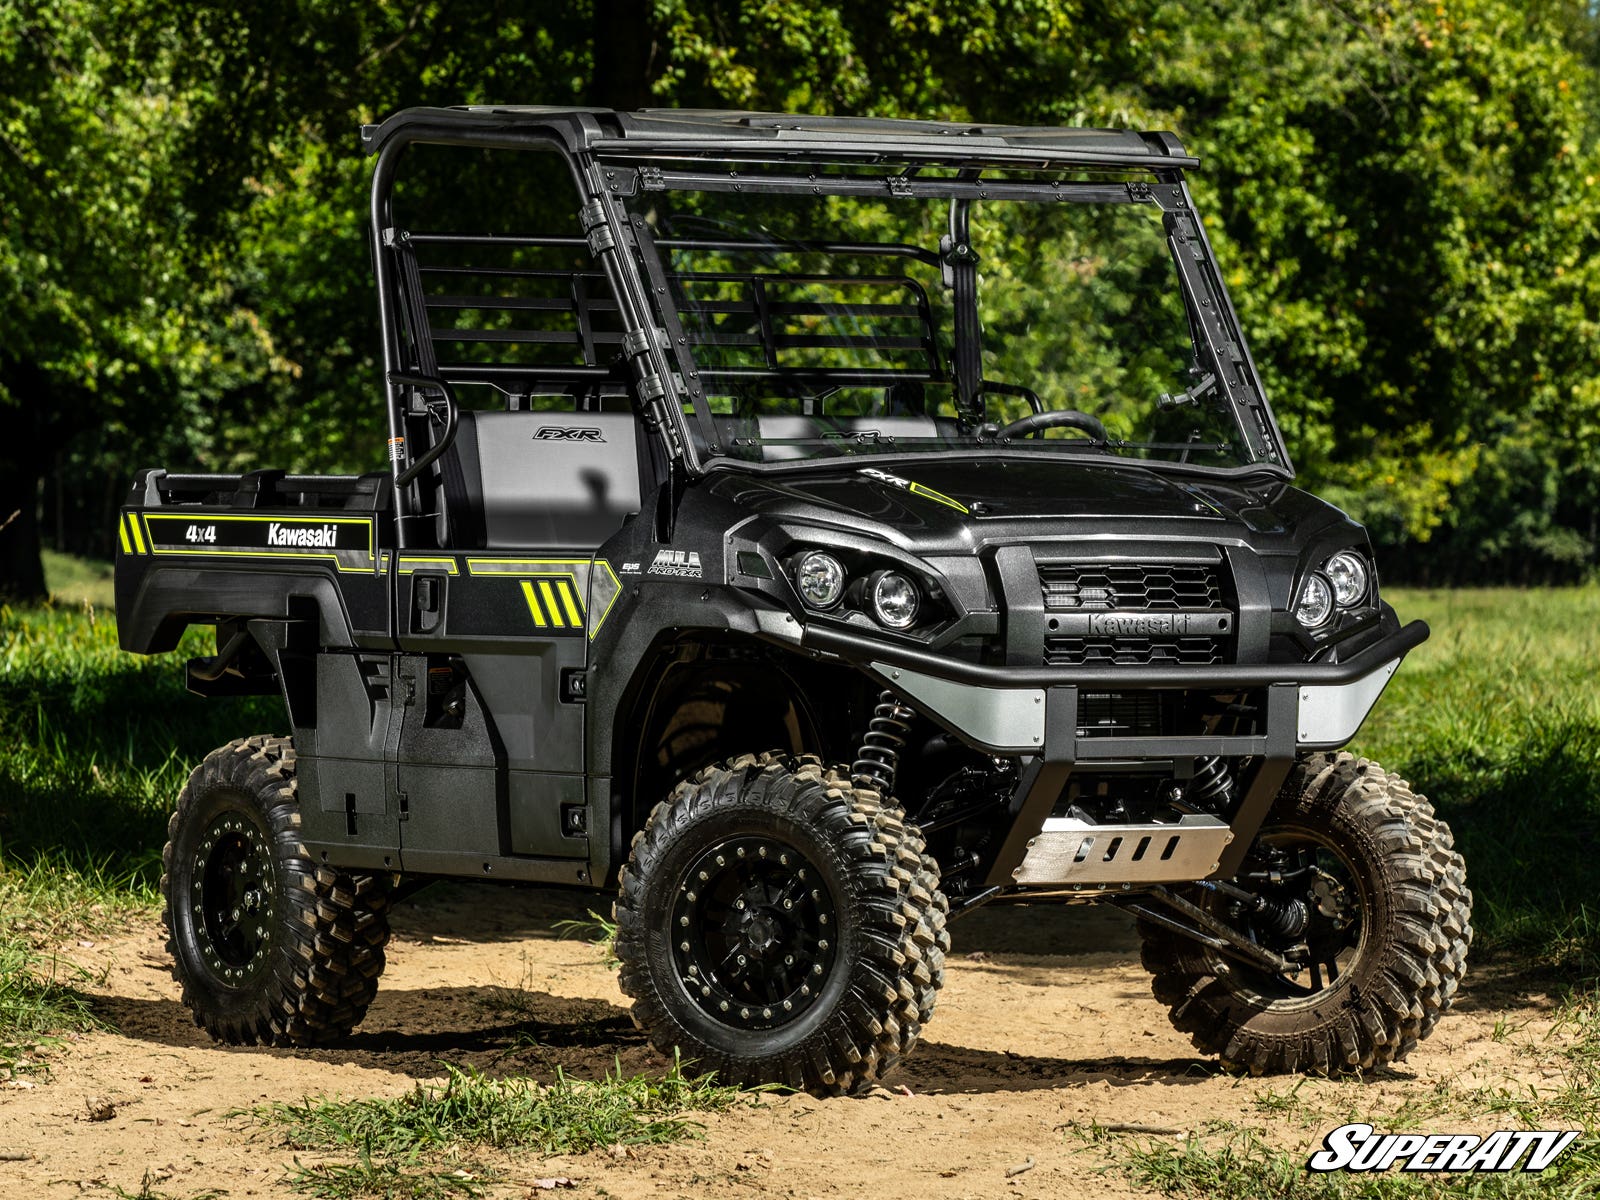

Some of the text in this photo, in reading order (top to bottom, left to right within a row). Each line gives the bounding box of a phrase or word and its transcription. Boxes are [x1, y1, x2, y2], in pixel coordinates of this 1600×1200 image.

[532, 426, 607, 443] FXR
[856, 468, 910, 489] FXR
[185, 525, 216, 543] 4x4
[267, 523, 337, 547] Kawasaki
[1089, 614, 1191, 634] Kawasaki
